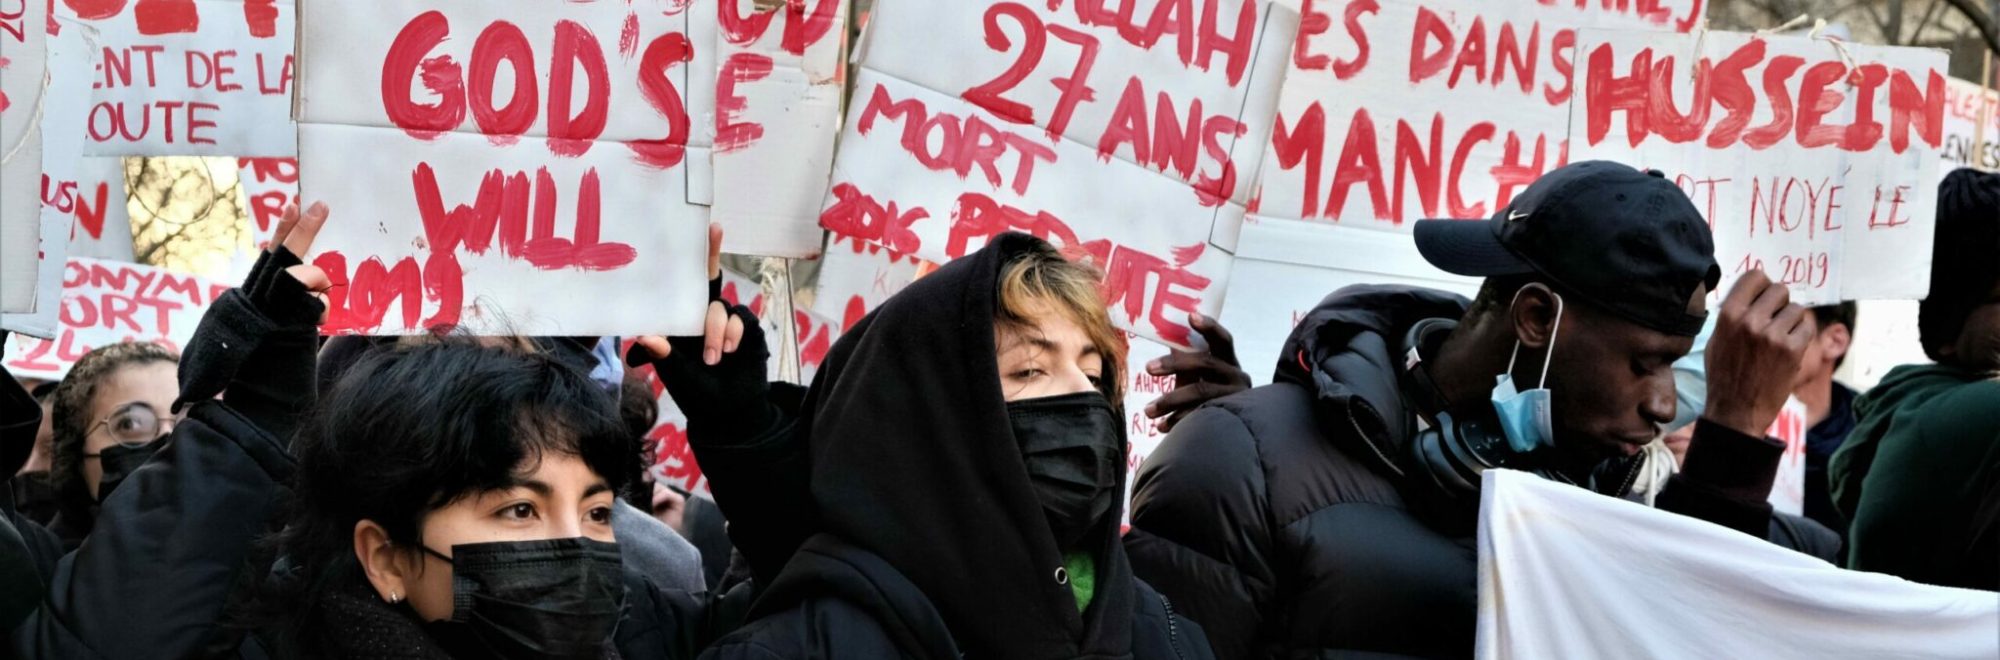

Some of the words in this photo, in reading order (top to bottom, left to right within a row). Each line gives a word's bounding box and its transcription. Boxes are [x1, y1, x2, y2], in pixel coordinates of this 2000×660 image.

[185, 50, 243, 92] DE
[382, 10, 694, 170] GOD'S
[962, 2, 1101, 142] 27
[1097, 76, 1247, 206] ANS
[1408, 6, 1576, 106] DANS
[1586, 39, 1946, 155] HUSSEIN
[86, 101, 220, 145] OUTE
[858, 83, 1058, 197] MORT
[1272, 100, 1568, 225] MANCH
[412, 161, 638, 272] WILL
[1750, 165, 1851, 240] NOYÉ
[1868, 184, 1912, 231] LE
[1779, 252, 1829, 288] 2019
